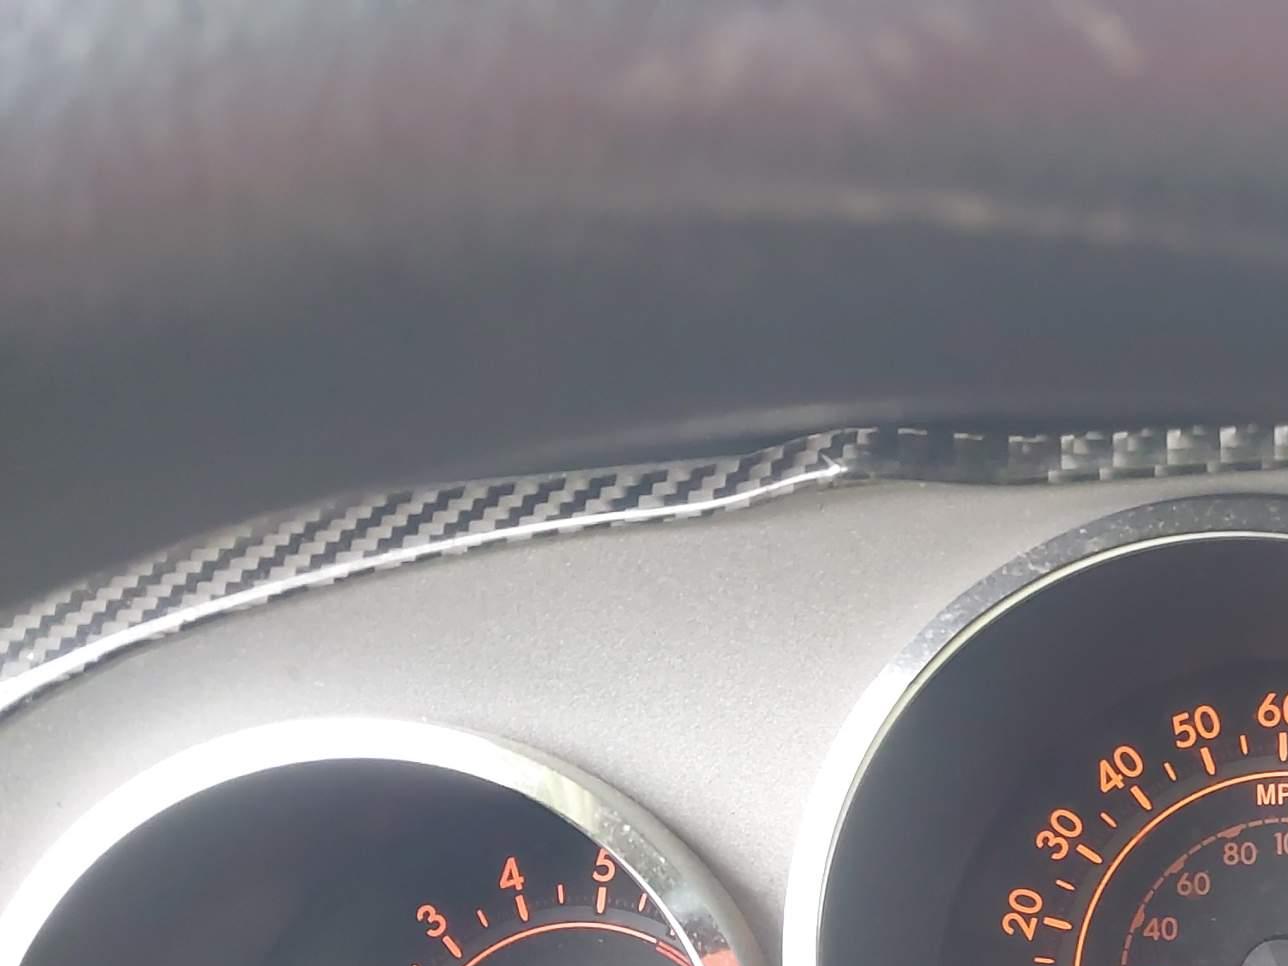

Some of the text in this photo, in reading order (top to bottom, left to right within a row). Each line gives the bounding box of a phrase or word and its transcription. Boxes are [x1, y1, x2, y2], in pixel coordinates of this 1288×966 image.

[1172, 705, 1220, 748] 50
[1099, 745, 1144, 793] 40
[1036, 809, 1083, 860] 30
[592, 847, 616, 882] 5
[1223, 842, 1257, 866] 80
[499, 857, 525, 891] 4
[1177, 872, 1211, 896] 60
[416, 905, 448, 938] 3
[1002, 888, 1043, 941] 20
[1143, 917, 1179, 940] 40
